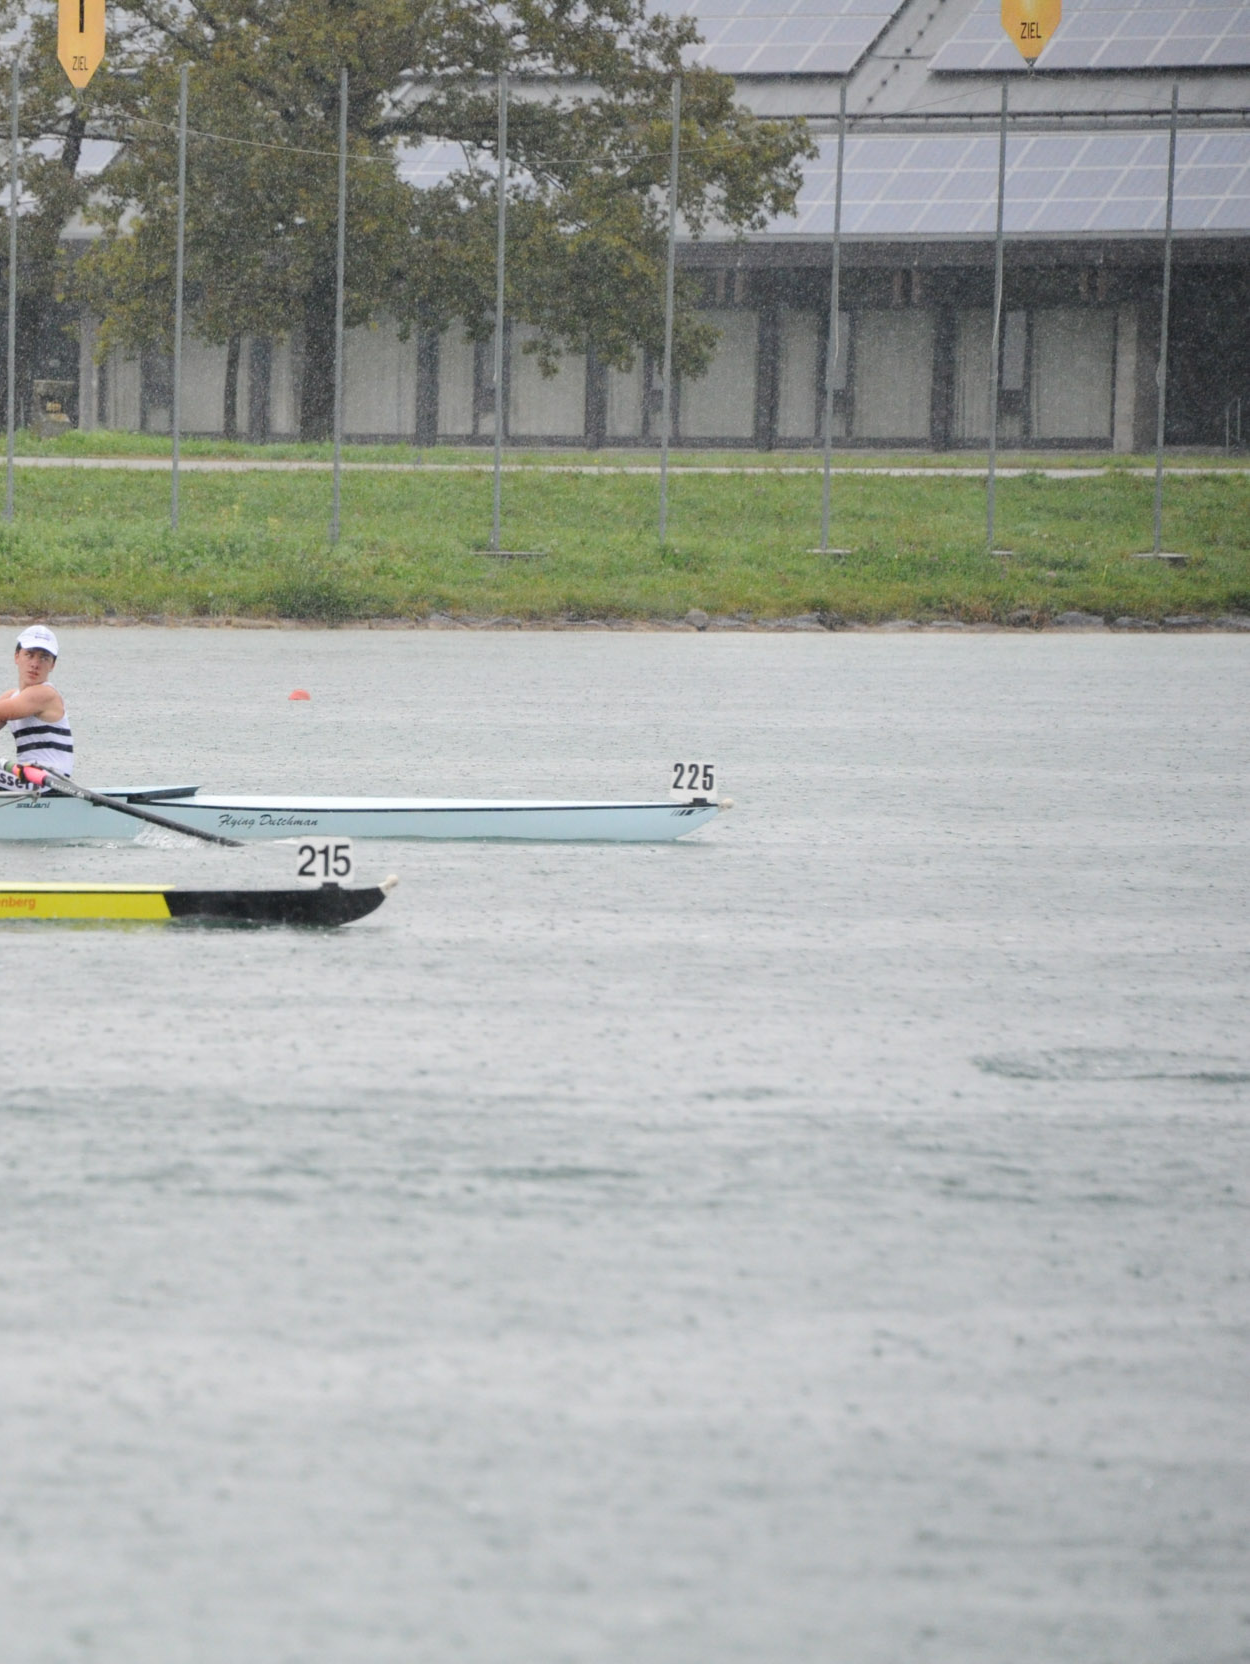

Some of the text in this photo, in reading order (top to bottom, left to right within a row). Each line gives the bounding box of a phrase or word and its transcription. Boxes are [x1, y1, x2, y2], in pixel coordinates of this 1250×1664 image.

[1020, 22, 1042, 39] ZIEL
[72, 56, 89, 71] ZIEL
[672, 763, 715, 791] 225
[218, 813, 319, 829] Flying Dutchman
[298, 845, 352, 877] 215
